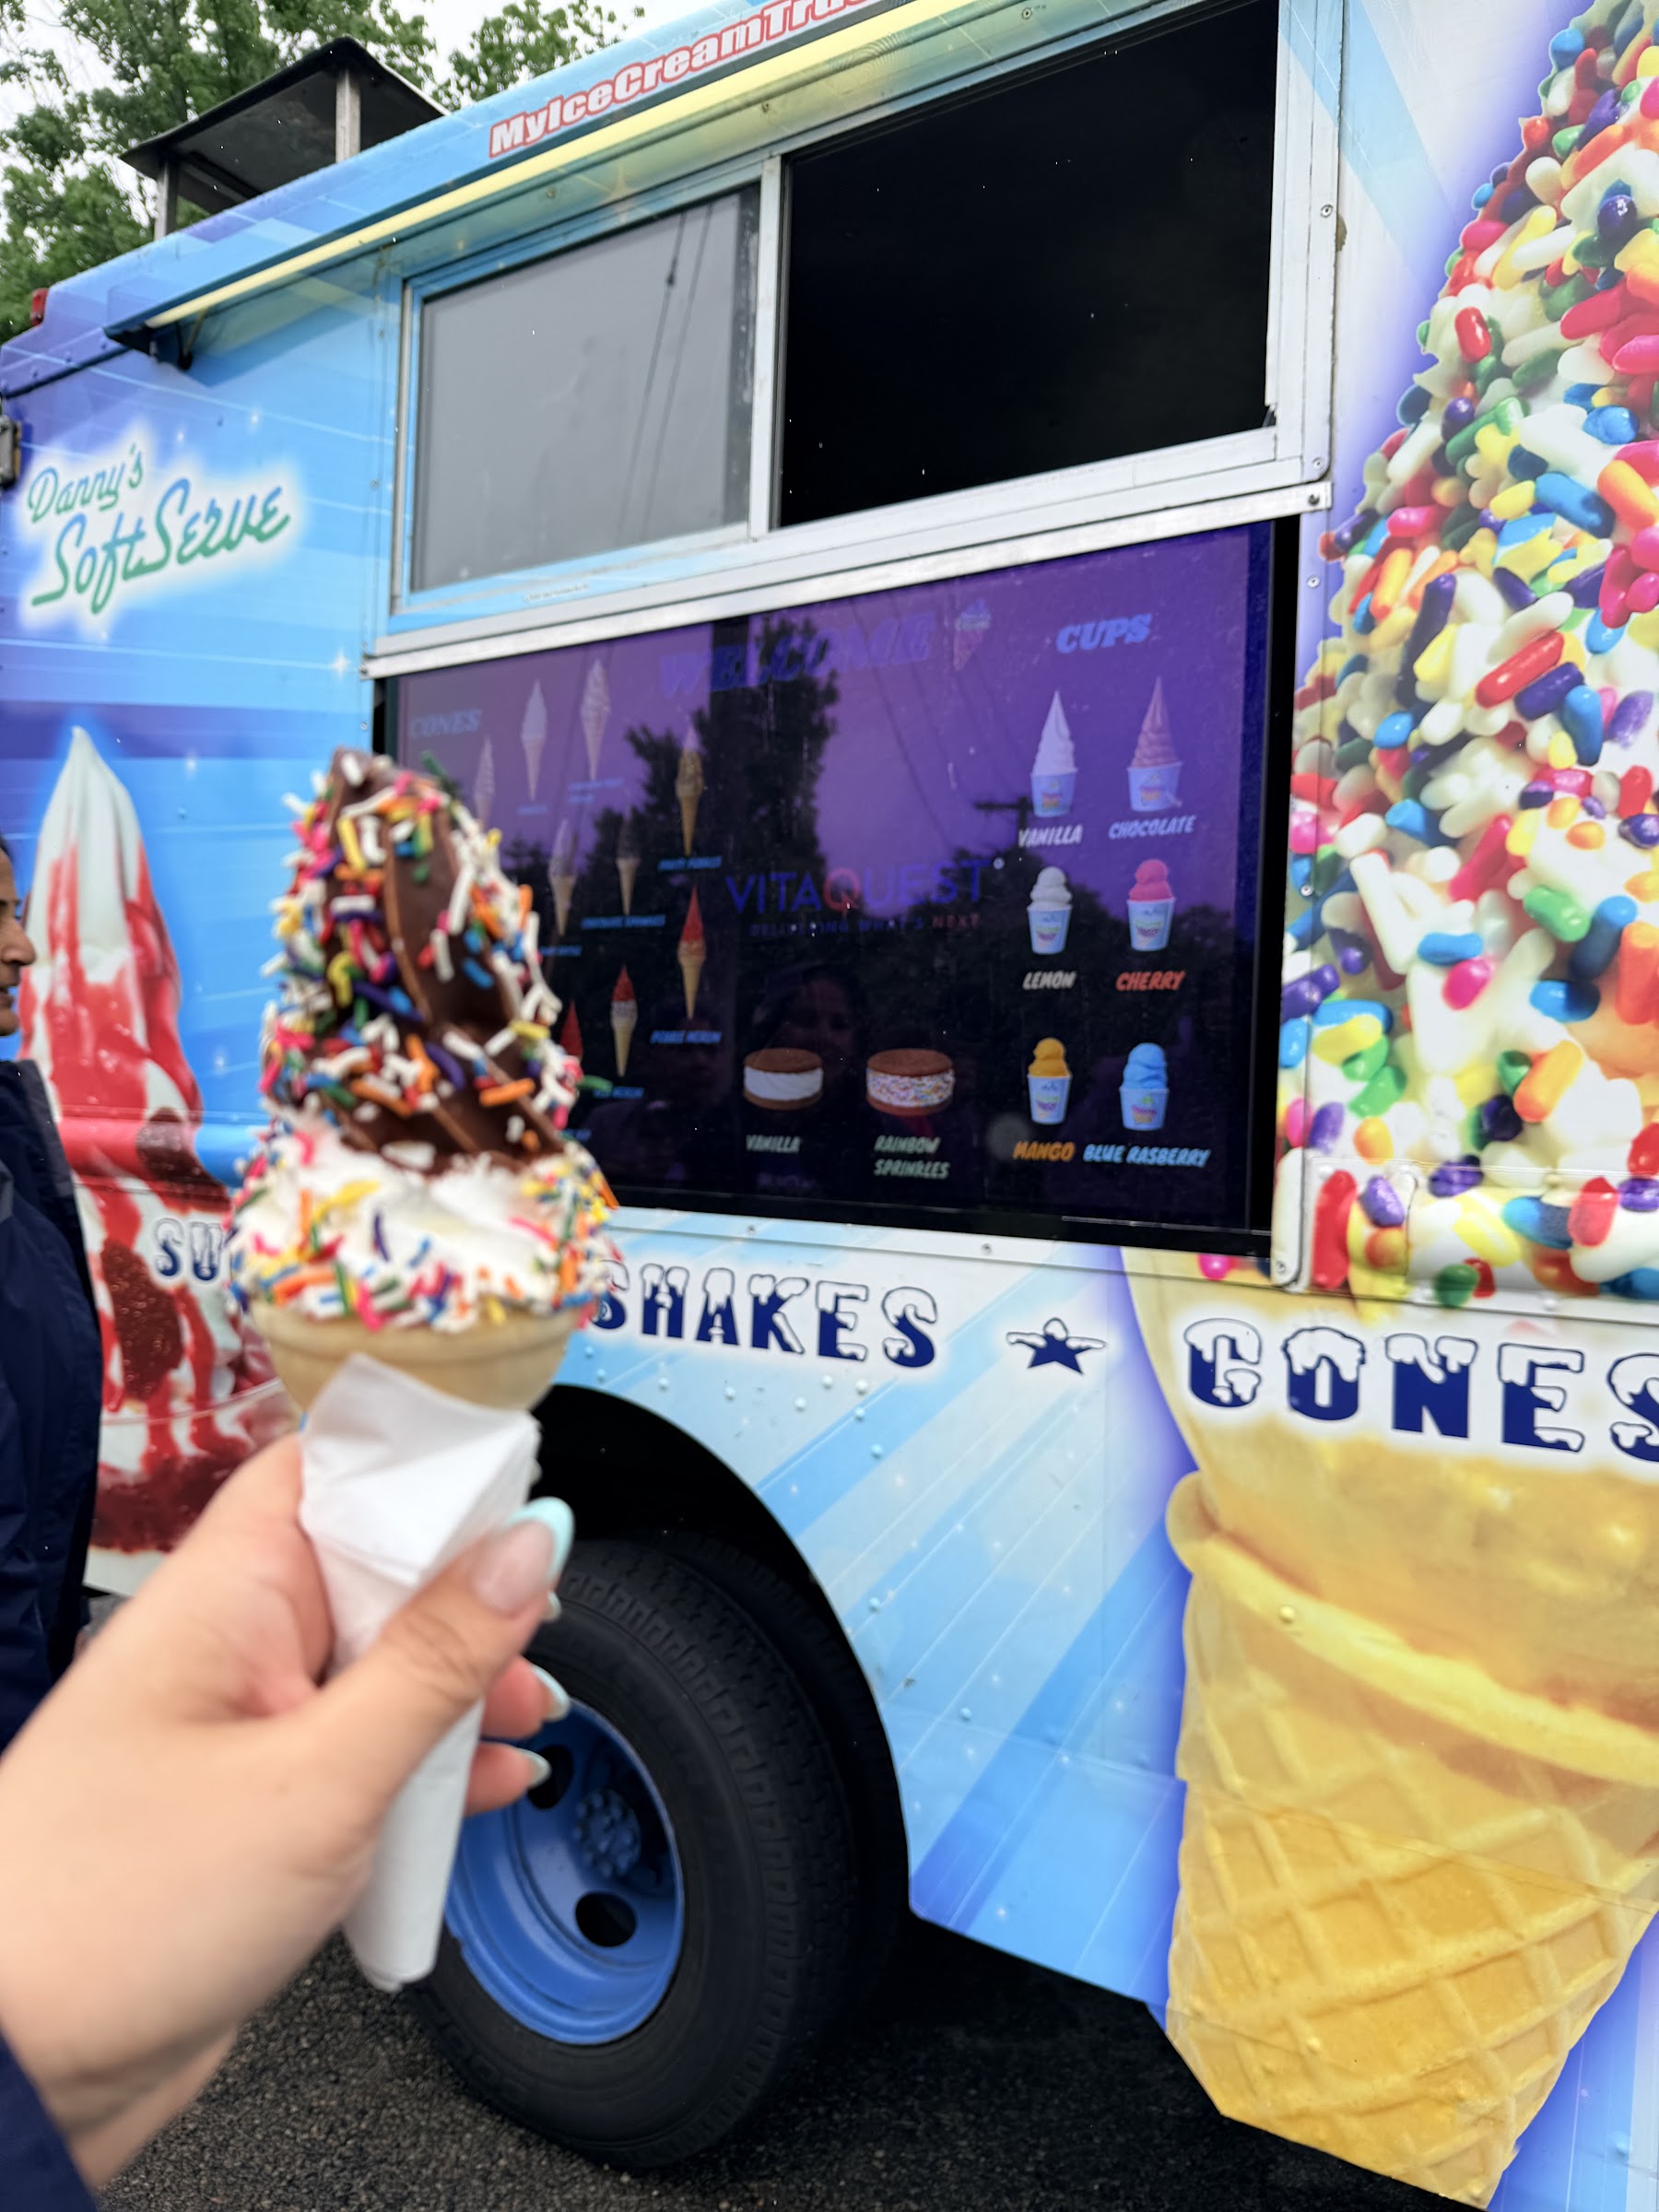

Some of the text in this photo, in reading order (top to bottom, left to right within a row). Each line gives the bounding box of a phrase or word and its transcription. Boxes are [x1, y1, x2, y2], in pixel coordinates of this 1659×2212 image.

[488, 0, 870, 159] MyIceCreamTr
[28, 442, 143, 523] Danny's
[1055, 613, 1153, 653] CUPS
[407, 708, 483, 739] CONES
[1018, 823, 1083, 847] VANILLA
[1108, 815, 1197, 841] CHOCOLATE
[724, 858, 991, 916] VITAQUEST
[1022, 970, 1077, 990] LEMON
[1115, 970, 1186, 991] CHERRY
[746, 1134, 800, 1154] VANILLA
[874, 1135, 942, 1154] RAINBOW
[1013, 1140, 1076, 1162] MANGO
[1082, 1143, 1212, 1168] BLUE RASBERRY
[874, 1158, 951, 1180] SPRINKLES
[588, 1259, 937, 1369] SHAKES
[1183, 1317, 1659, 1463] CONES
